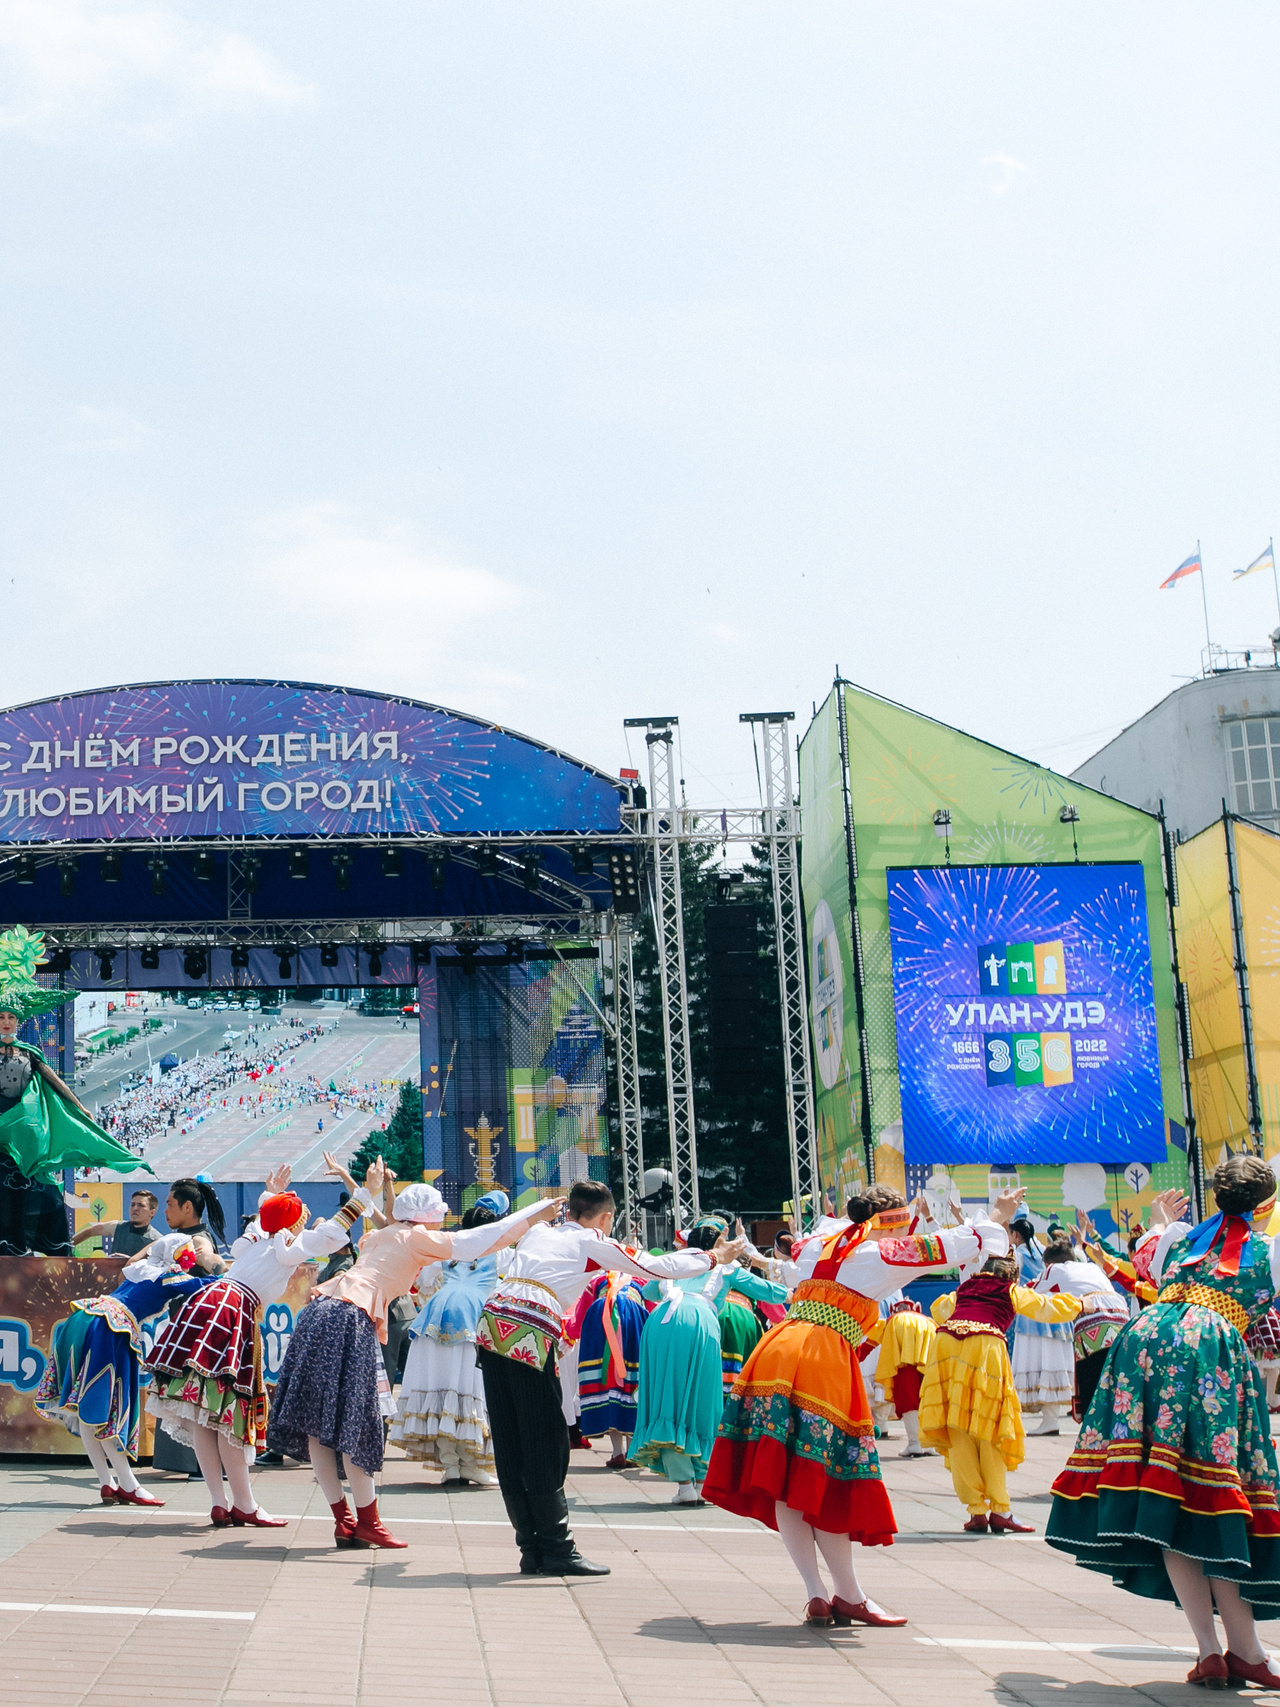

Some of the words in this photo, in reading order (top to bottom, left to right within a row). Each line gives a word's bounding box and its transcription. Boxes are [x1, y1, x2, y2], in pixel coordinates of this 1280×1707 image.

[21, 733, 141, 773] ДНЁМ
[154, 731, 409, 767] РОЖДЕНИЯ,
[238, 779, 392, 813] ГОРОД!
[945, 1001, 1106, 1029] УЛАН-УДЭ
[951, 1041, 980, 1054] 1666
[987, 1039, 1070, 1073] 356
[1075, 1039, 1108, 1053] 2022
